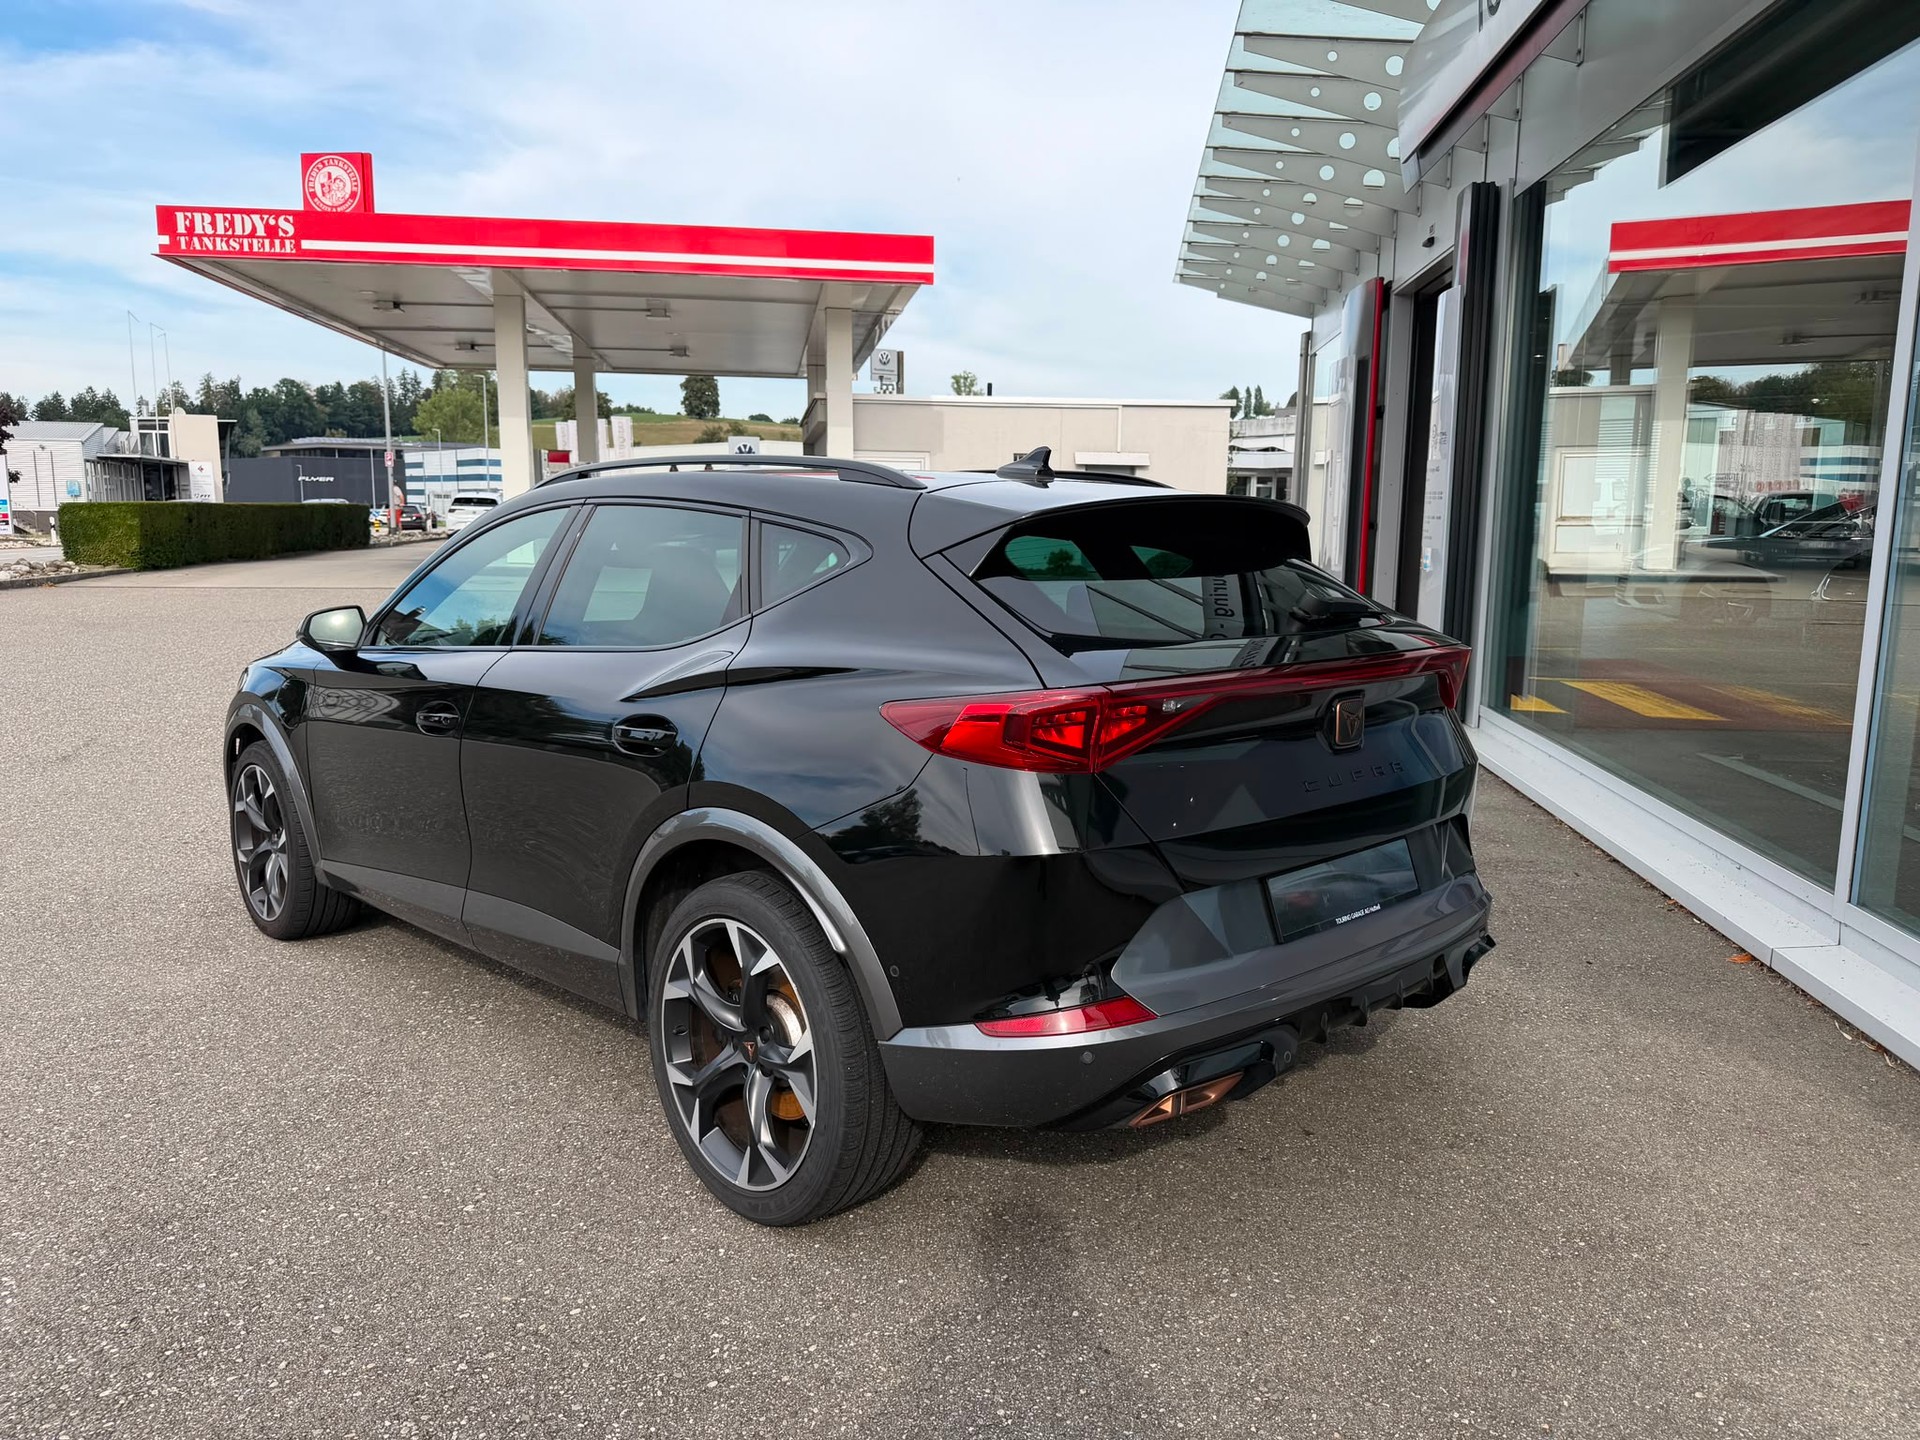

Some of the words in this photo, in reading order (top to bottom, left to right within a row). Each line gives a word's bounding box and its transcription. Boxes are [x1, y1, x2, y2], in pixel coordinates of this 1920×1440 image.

[322, 158, 358, 192] TANKSTELLE
[174, 211, 296, 238] FREDY'S
[175, 235, 297, 254] TANKSTELLE
[1303, 761, 1405, 793] CUPRA
